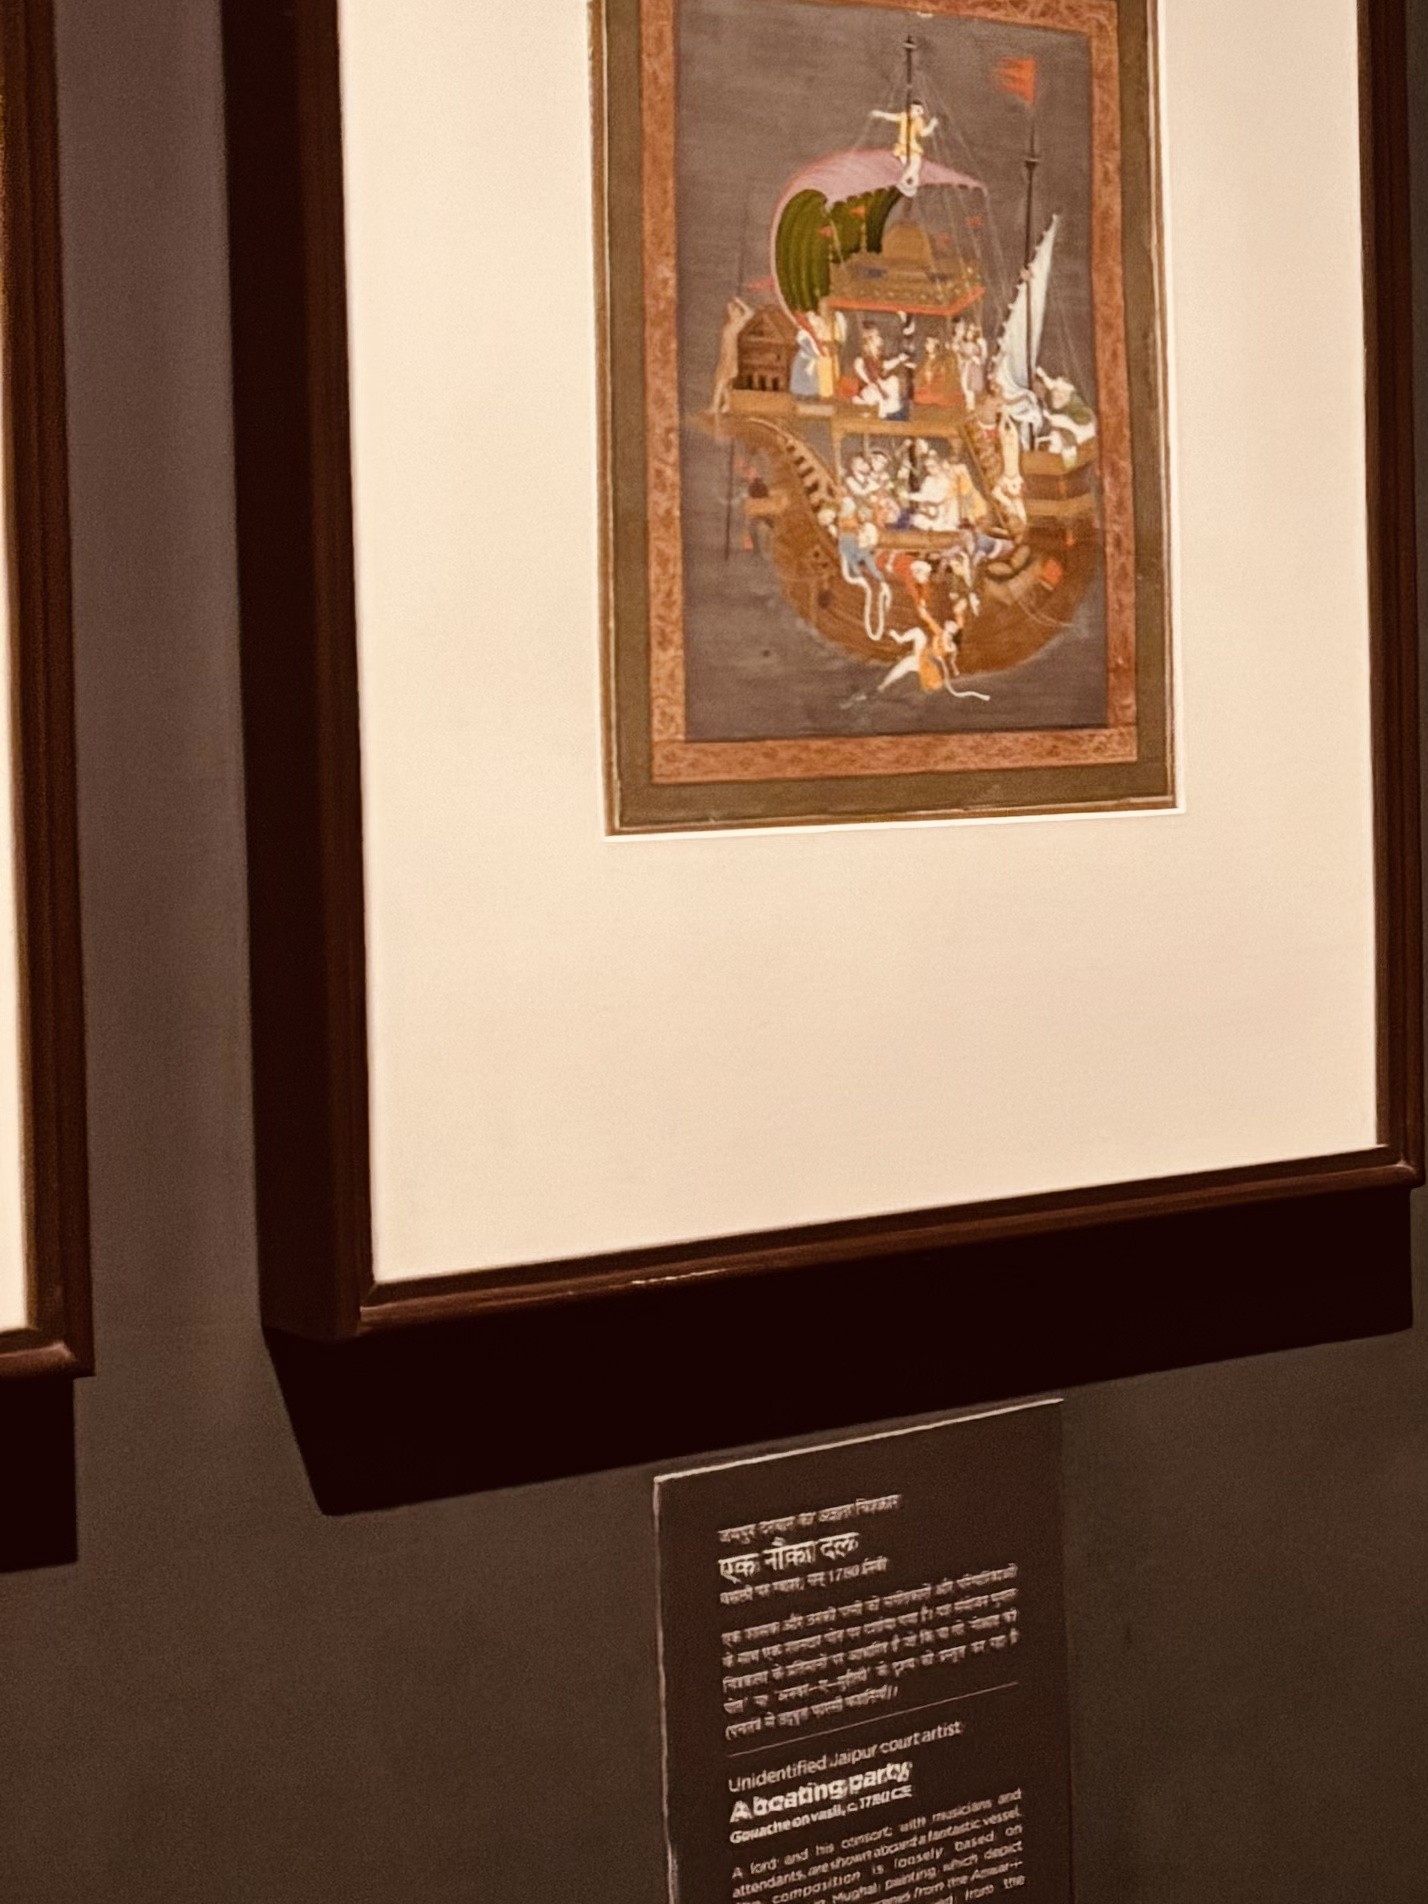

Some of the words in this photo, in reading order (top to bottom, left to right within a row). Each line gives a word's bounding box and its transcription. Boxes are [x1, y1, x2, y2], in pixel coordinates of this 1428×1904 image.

[717, 1552, 760, 1584] एक
[761, 1536, 816, 1570] नौका
[816, 1531, 859, 1559] दल
[728, 1754, 827, 1792] Unidentified
[828, 1743, 877, 1767] Jaipur
[878, 1732, 920, 1753] court
[921, 1721, 961, 1742] artist
[729, 1800, 753, 1822] A
[752, 1778, 847, 1817] boating
[847, 1761, 912, 1794] party
[729, 1819, 791, 1843] Gouache
[790, 1813, 812, 1827] on
[890, 1784, 912, 1800] CE
[731, 1867, 742, 1878] A
[784, 1848, 808, 1865] and
[815, 1843, 834, 1855] his
[899, 1816, 926, 1831] with
[932, 1799, 992, 1821] musicians
[997, 1787, 1021, 1804] and
[807, 1862, 828, 1876] are
[829, 1849, 872, 1869] shown
[927, 1819, 981, 1841] fantastic
[772, 1871, 860, 1904] composition
[872, 1864, 883, 1874] is
[894, 1847, 943, 1867] loosely
[954, 1830, 994, 1851] based
[1005, 1824, 1022, 1836] on
[832, 1882, 877, 1904] Mughal
[942, 1853, 978, 1871] which
[983, 1840, 1022, 1859] depict
[913, 1881, 944, 1898] from
[947, 1875, 968, 1888] the
[964, 1884, 993, 1900] from
[1003, 1875, 1024, 1888] the
